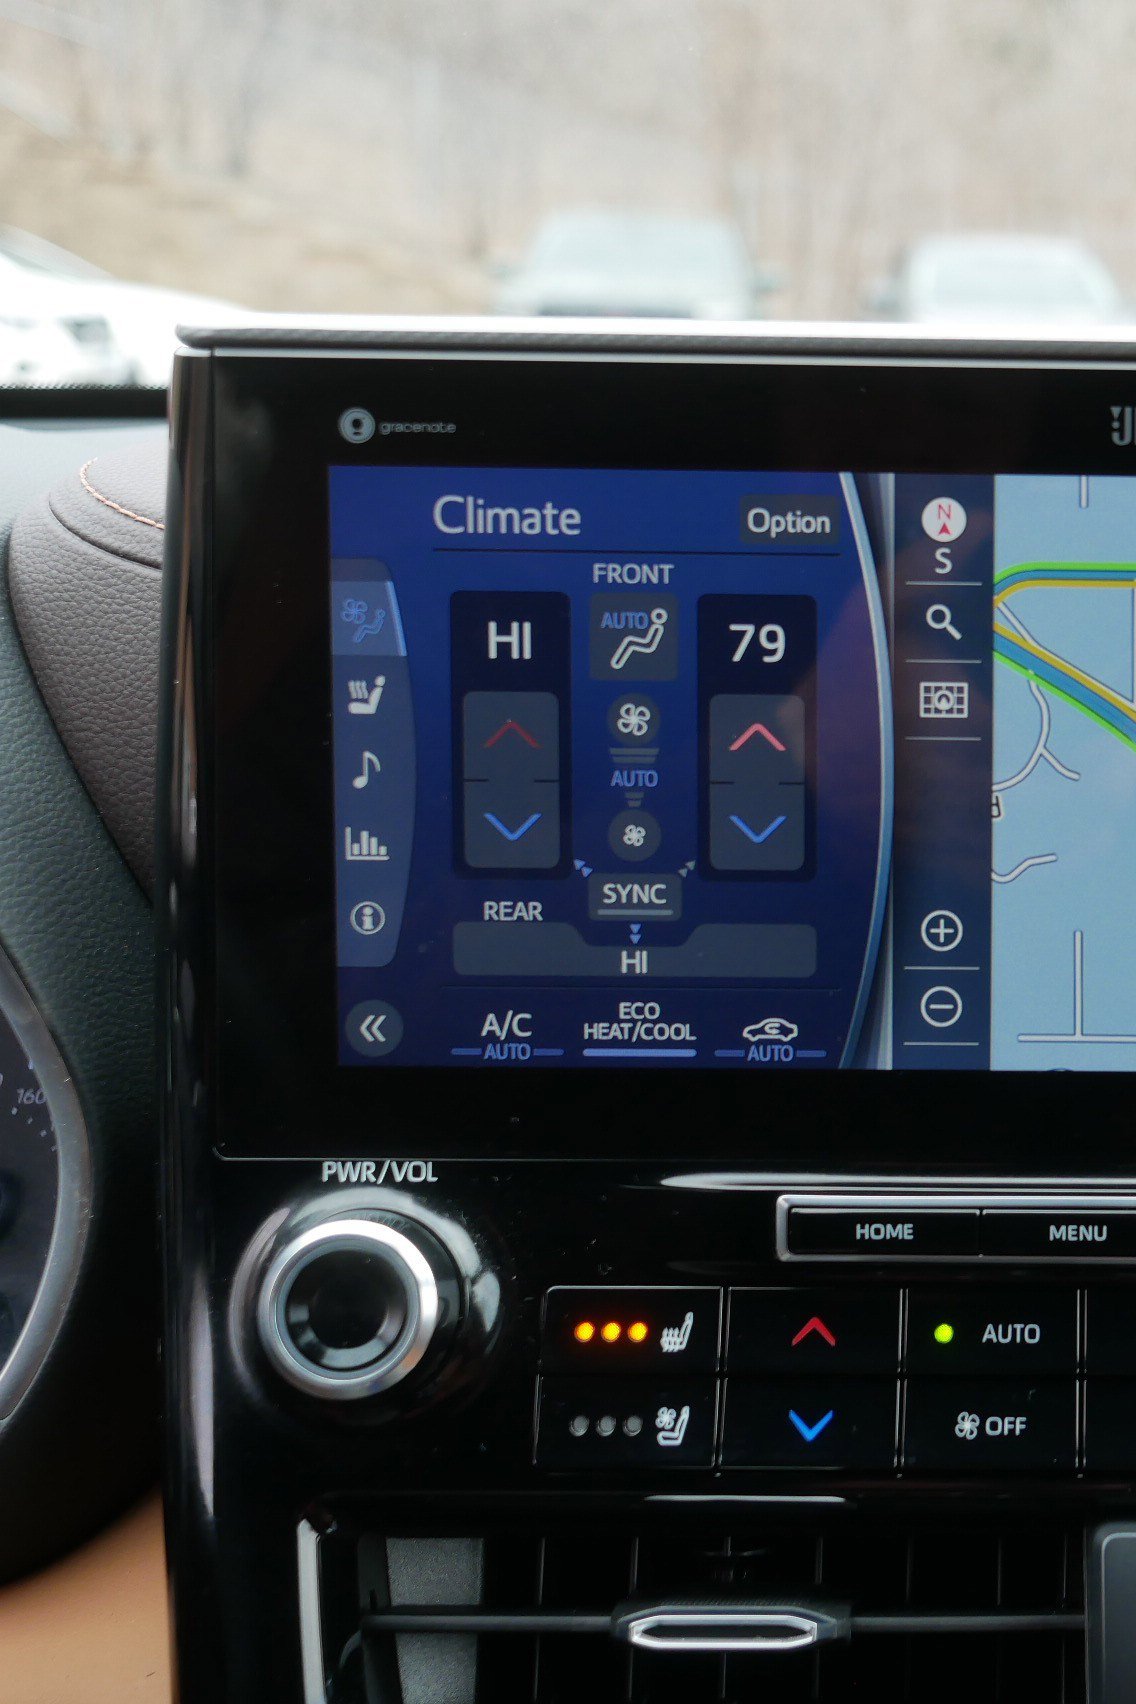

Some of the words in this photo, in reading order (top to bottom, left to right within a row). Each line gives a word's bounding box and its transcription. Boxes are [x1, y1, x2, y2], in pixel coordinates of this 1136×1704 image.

[379, 421, 457, 436] gracenote
[432, 494, 582, 536] Climate
[746, 507, 832, 537] Option
[937, 502, 952, 521] N
[935, 547, 953, 574] S
[592, 563, 674, 585] FRONT
[601, 611, 649, 630] AUTO
[487, 621, 533, 660] HI
[728, 623, 786, 662] 79
[611, 770, 658, 788] AUTO
[602, 883, 667, 905] SYNC
[483, 900, 543, 921] REAR
[620, 951, 648, 974] HI
[618, 1002, 661, 1020] ECO
[480, 1011, 533, 1039] A/C
[583, 1023, 696, 1042] HEAT/COOL
[483, 1043, 532, 1062] AUTO
[747, 1045, 794, 1063] AUTO
[321, 1160, 439, 1184] PWR/VOL
[855, 1223, 914, 1241] HOME
[1049, 1223, 1108, 1242] MENU
[981, 1323, 1042, 1346] AUTO
[985, 1416, 1027, 1437] OFF
